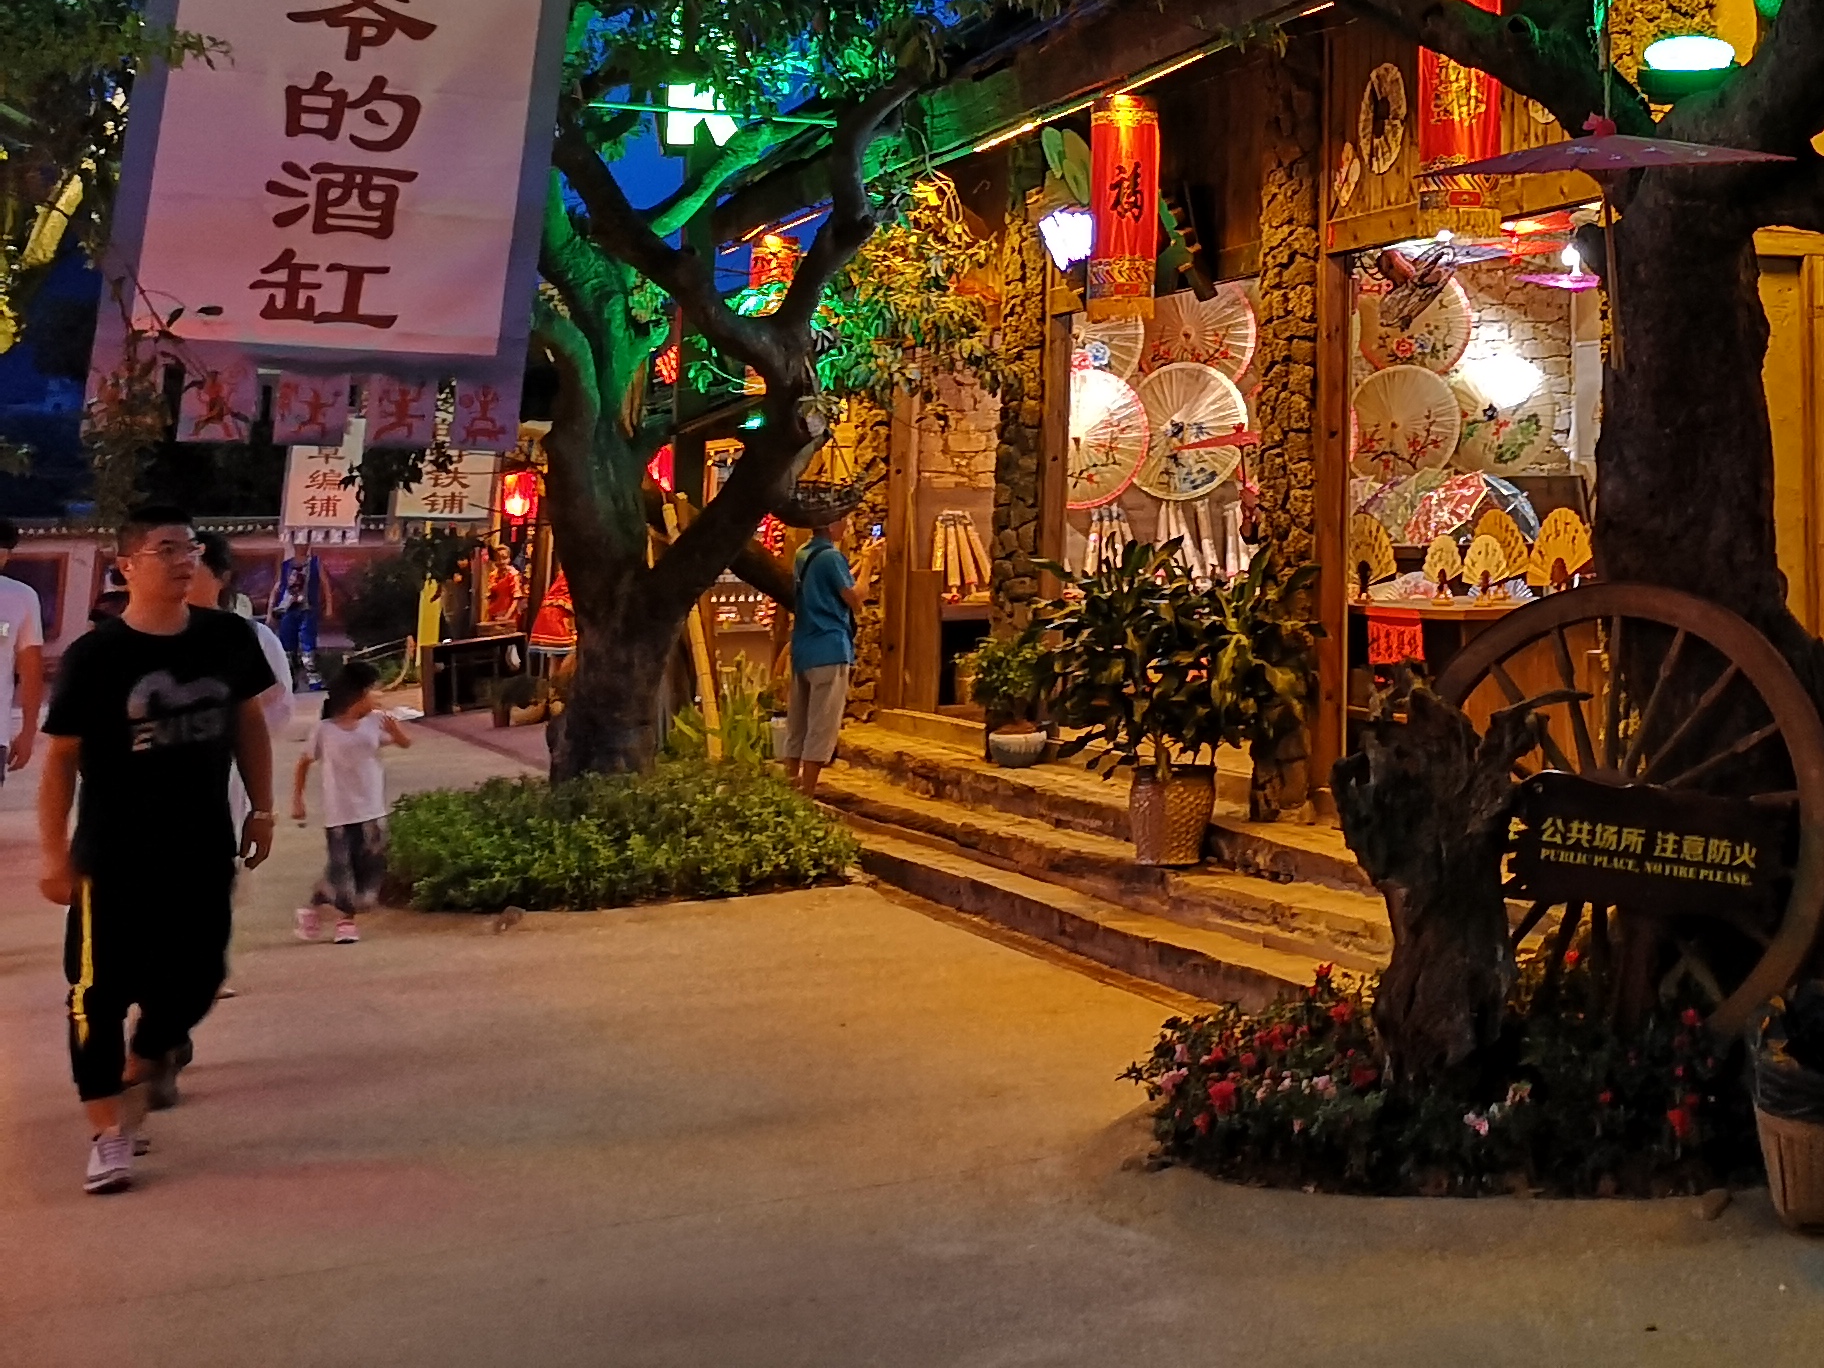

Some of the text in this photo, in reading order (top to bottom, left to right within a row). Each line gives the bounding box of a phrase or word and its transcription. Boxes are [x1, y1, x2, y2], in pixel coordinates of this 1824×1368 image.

[1109, 162, 1144, 223] 福
[1540, 816, 1758, 869] 公共场所 注意防火
[1540, 847, 1588, 865] PUBLIC
[1643, 860, 1663, 875] NO
[1664, 863, 1697, 880] FIRE
